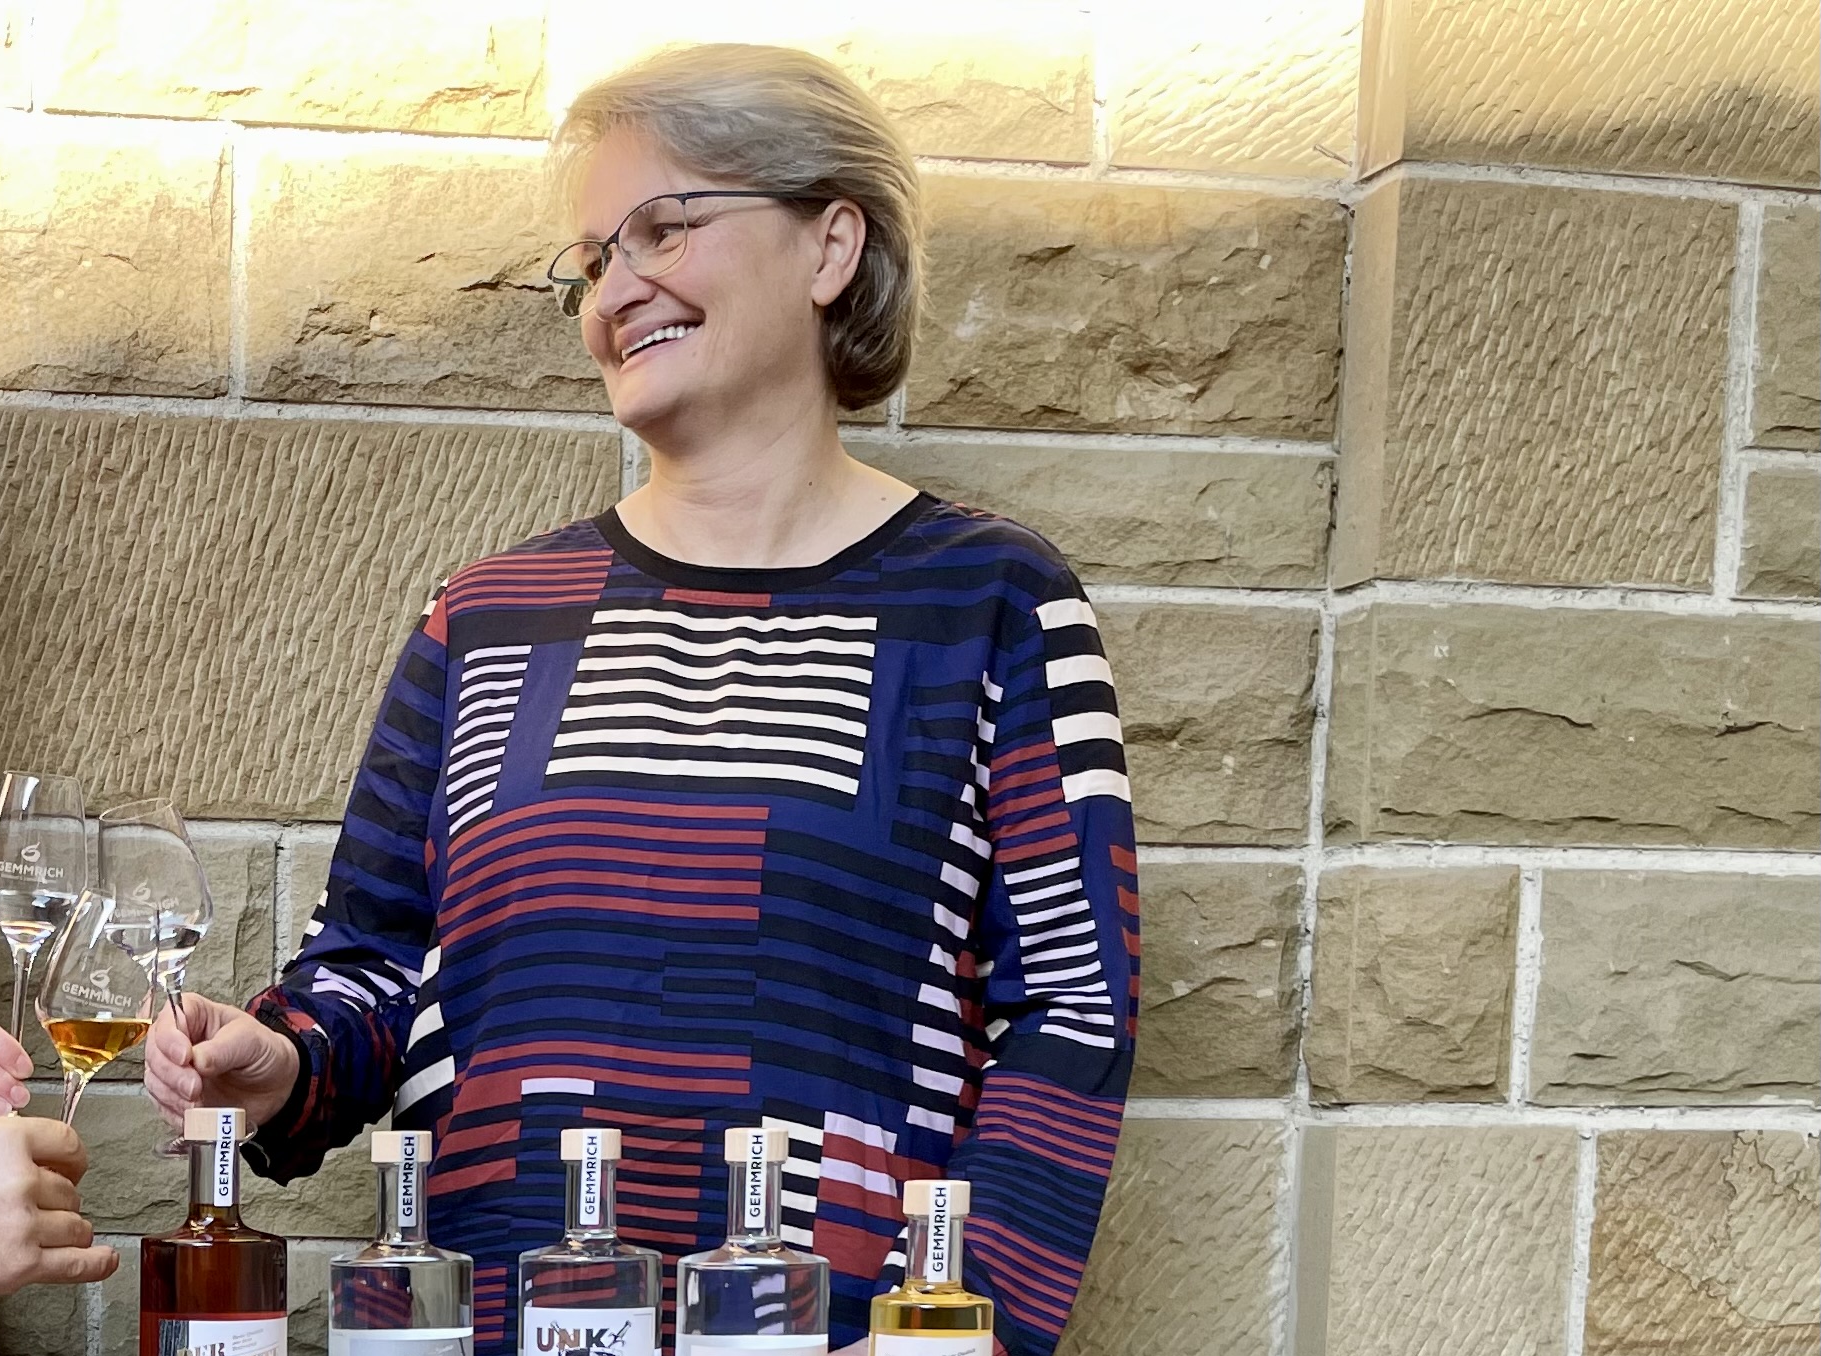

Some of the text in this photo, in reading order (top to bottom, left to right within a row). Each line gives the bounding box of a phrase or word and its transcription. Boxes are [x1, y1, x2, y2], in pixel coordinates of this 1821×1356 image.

[61, 981, 132, 1008] GEMMRICH
[218, 1114, 232, 1196] GEMMRICH
[402, 1136, 415, 1217] GEMMRICH
[584, 1135, 598, 1215] GEMMRICH
[749, 1134, 764, 1218] GEMMRICH
[933, 1187, 947, 1272] GEMMRICH
[536, 1327, 609, 1352] UNK
